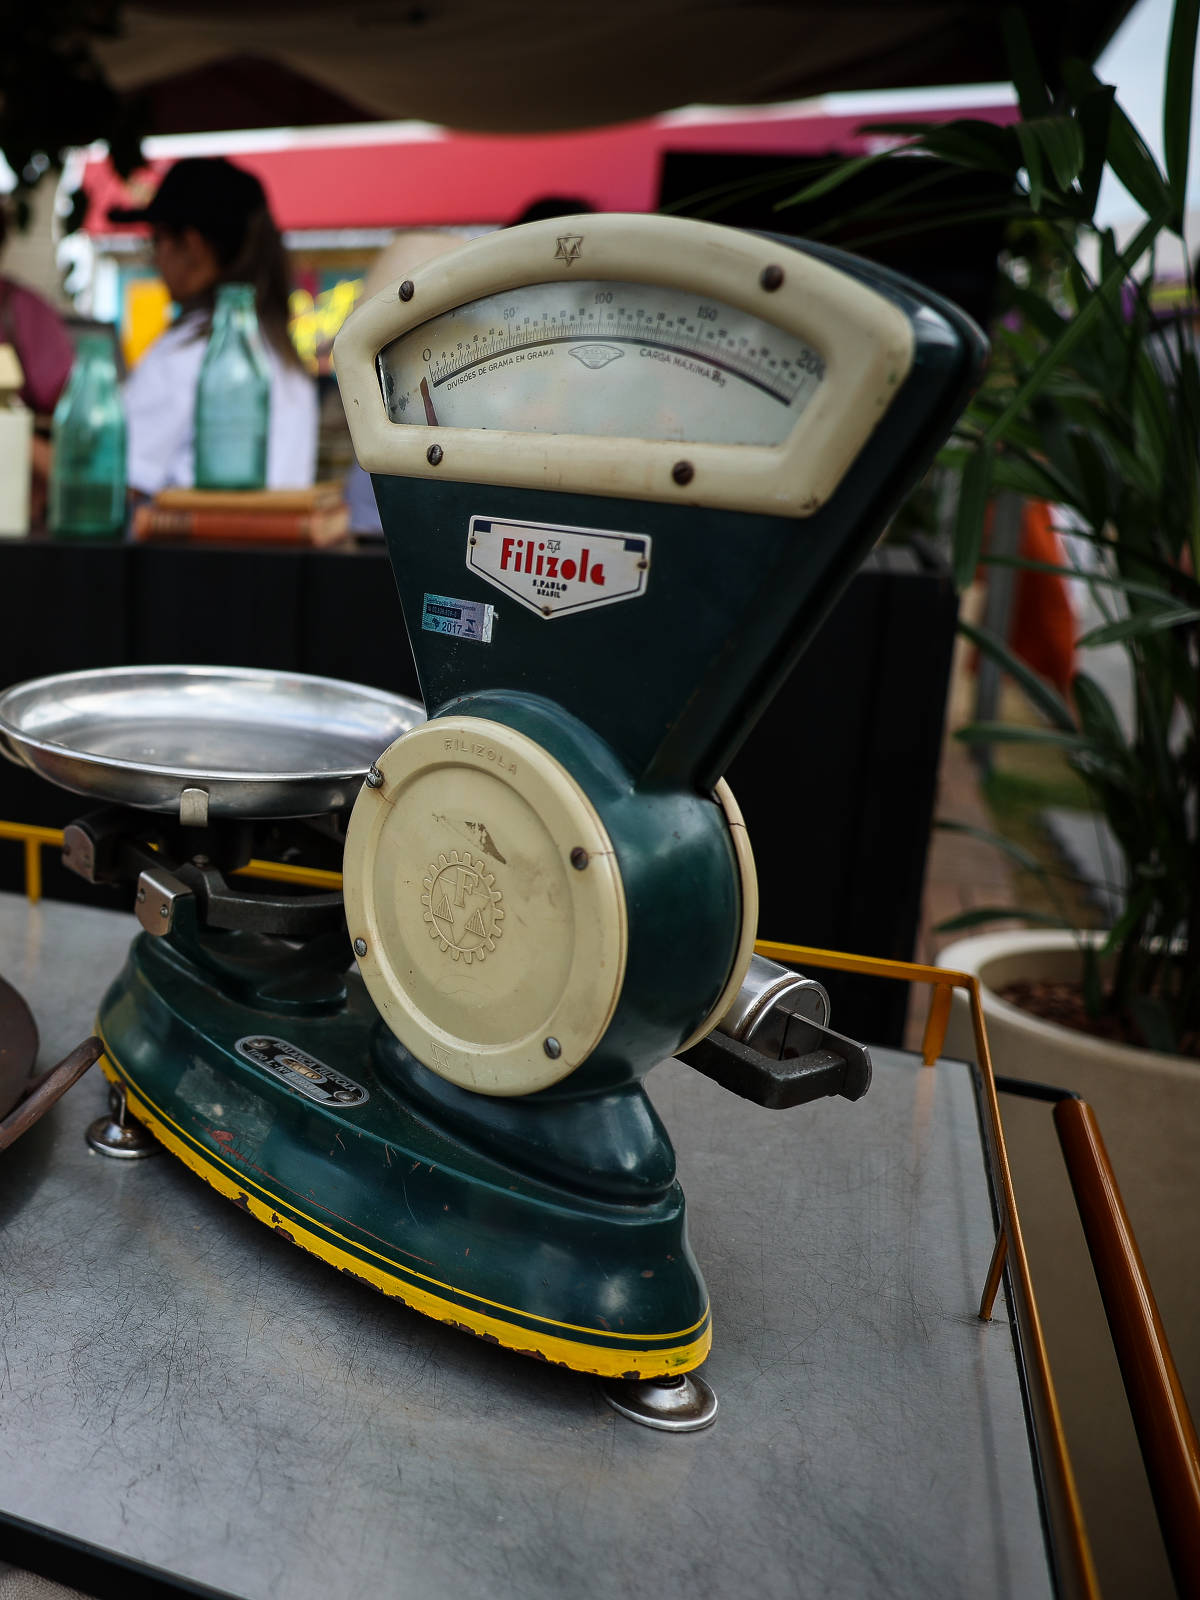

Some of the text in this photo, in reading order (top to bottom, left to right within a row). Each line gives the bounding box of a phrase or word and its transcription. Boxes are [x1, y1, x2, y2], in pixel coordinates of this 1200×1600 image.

[422, 348, 431, 361] 0
[503, 308, 515, 321] 50
[595, 292, 614, 304] 100
[696, 305, 718, 322] 150
[447, 348, 555, 390] DIVISÕES DE GRAMA EM GRAMA
[639, 347, 671, 363] CARGA
[500, 538, 605, 586] Filizola
[537, 589, 561, 599] BRASIL
[442, 622, 462, 634] 2017
[443, 737, 518, 776] FILIZOLA
